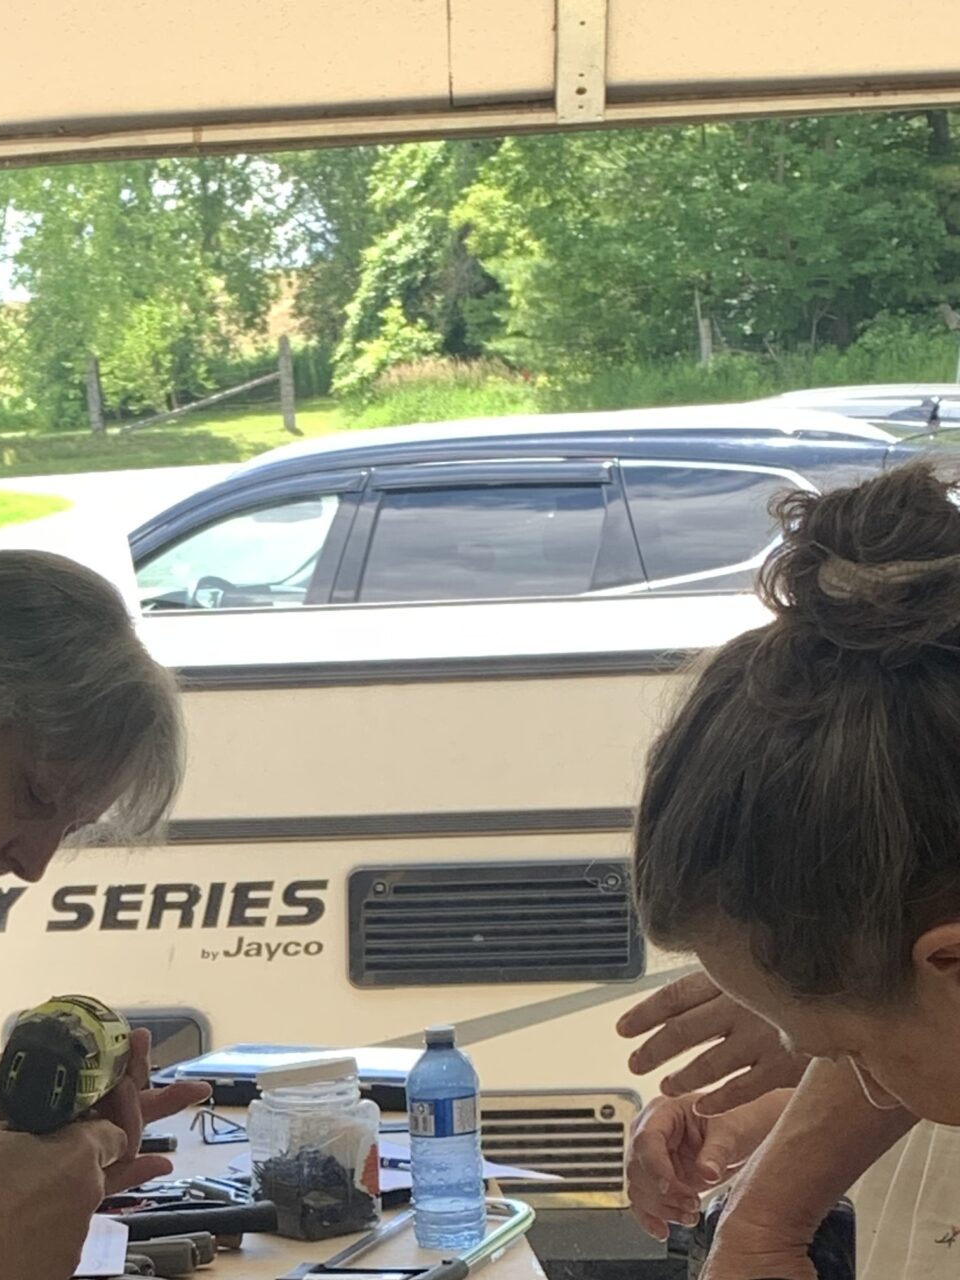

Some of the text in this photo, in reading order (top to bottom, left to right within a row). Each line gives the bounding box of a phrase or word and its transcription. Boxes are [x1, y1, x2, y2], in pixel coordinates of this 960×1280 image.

[45, 879, 329, 933] SERIES
[201, 936, 324, 963] by Jayco
